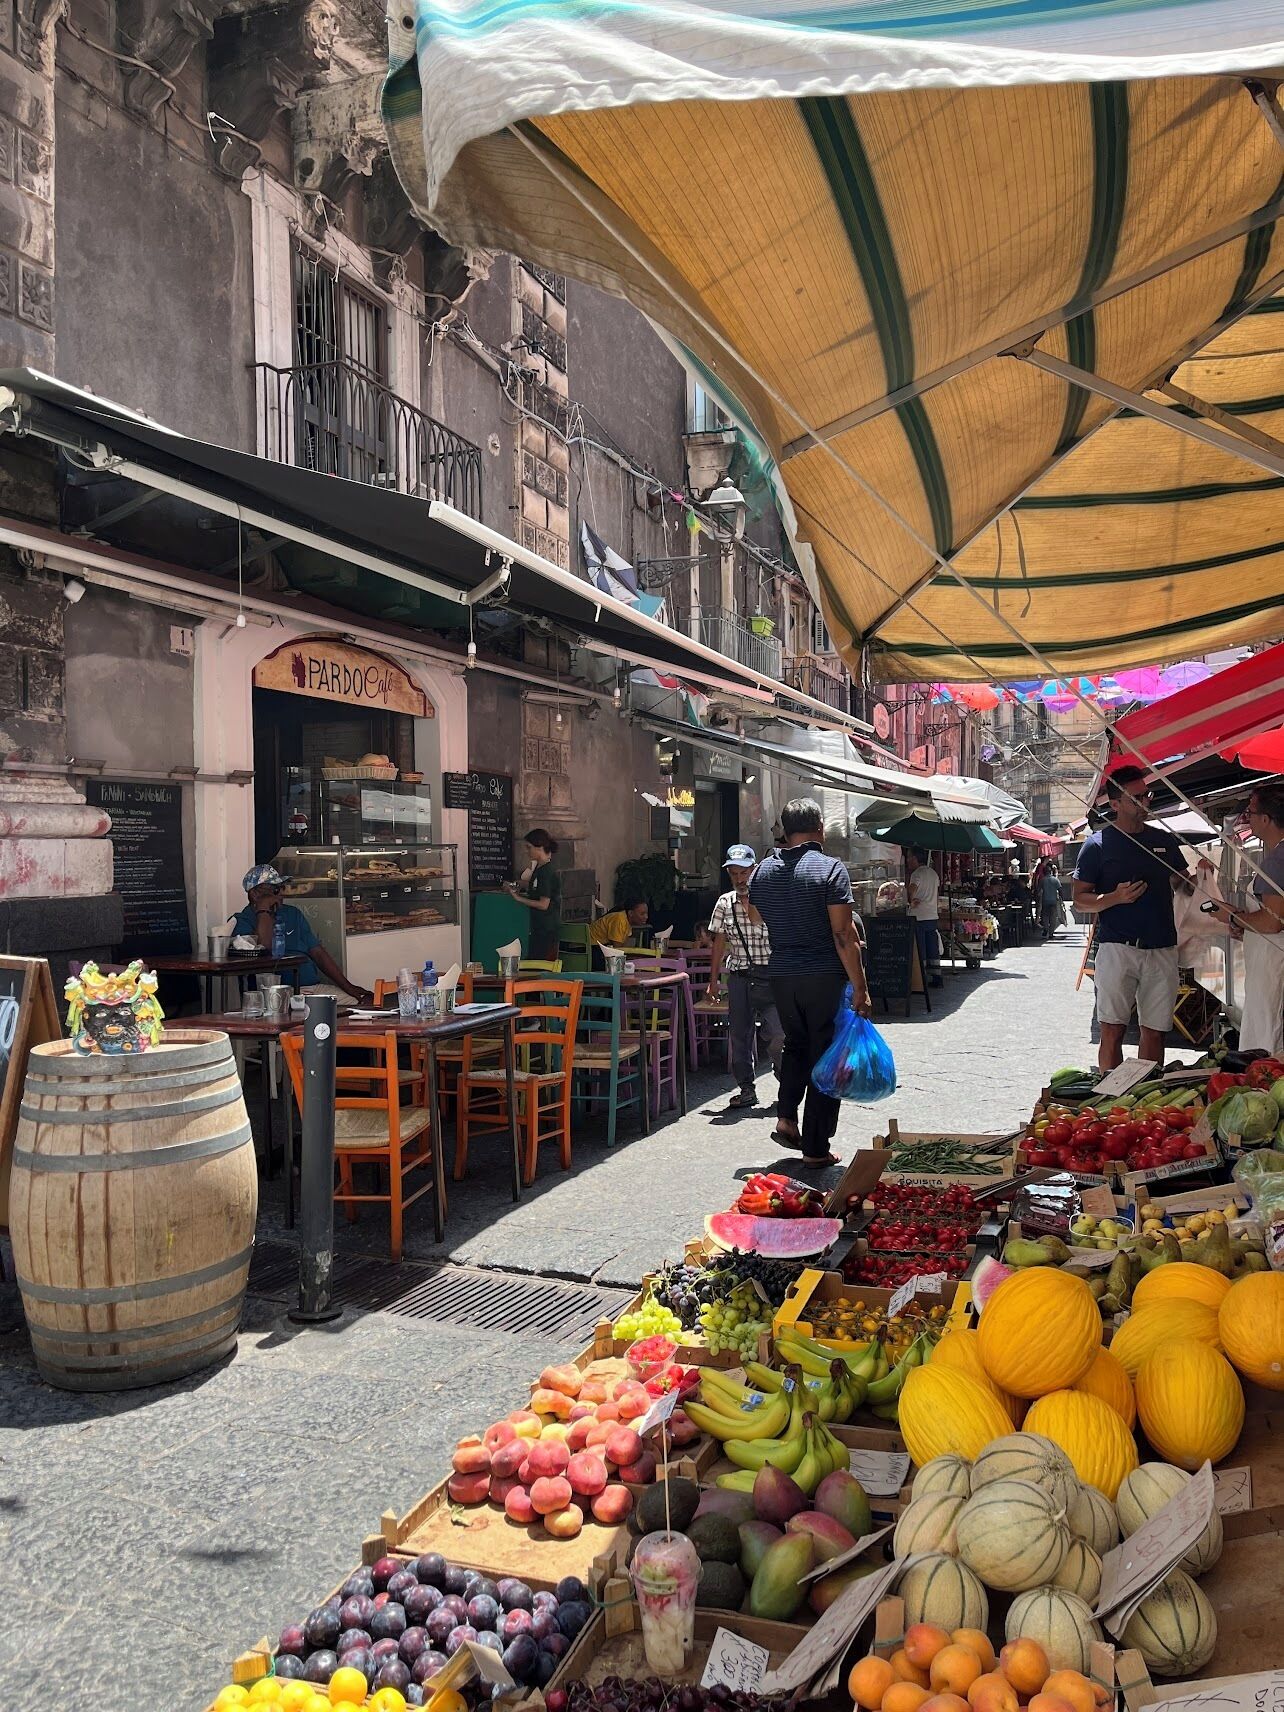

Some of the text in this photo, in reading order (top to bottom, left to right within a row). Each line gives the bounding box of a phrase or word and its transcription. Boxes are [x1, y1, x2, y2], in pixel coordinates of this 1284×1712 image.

[180, 629, 185, 646] 1
[308, 656, 394, 705] PARDO Café
[101, 784, 172, 803] PANINI SANDWICH
